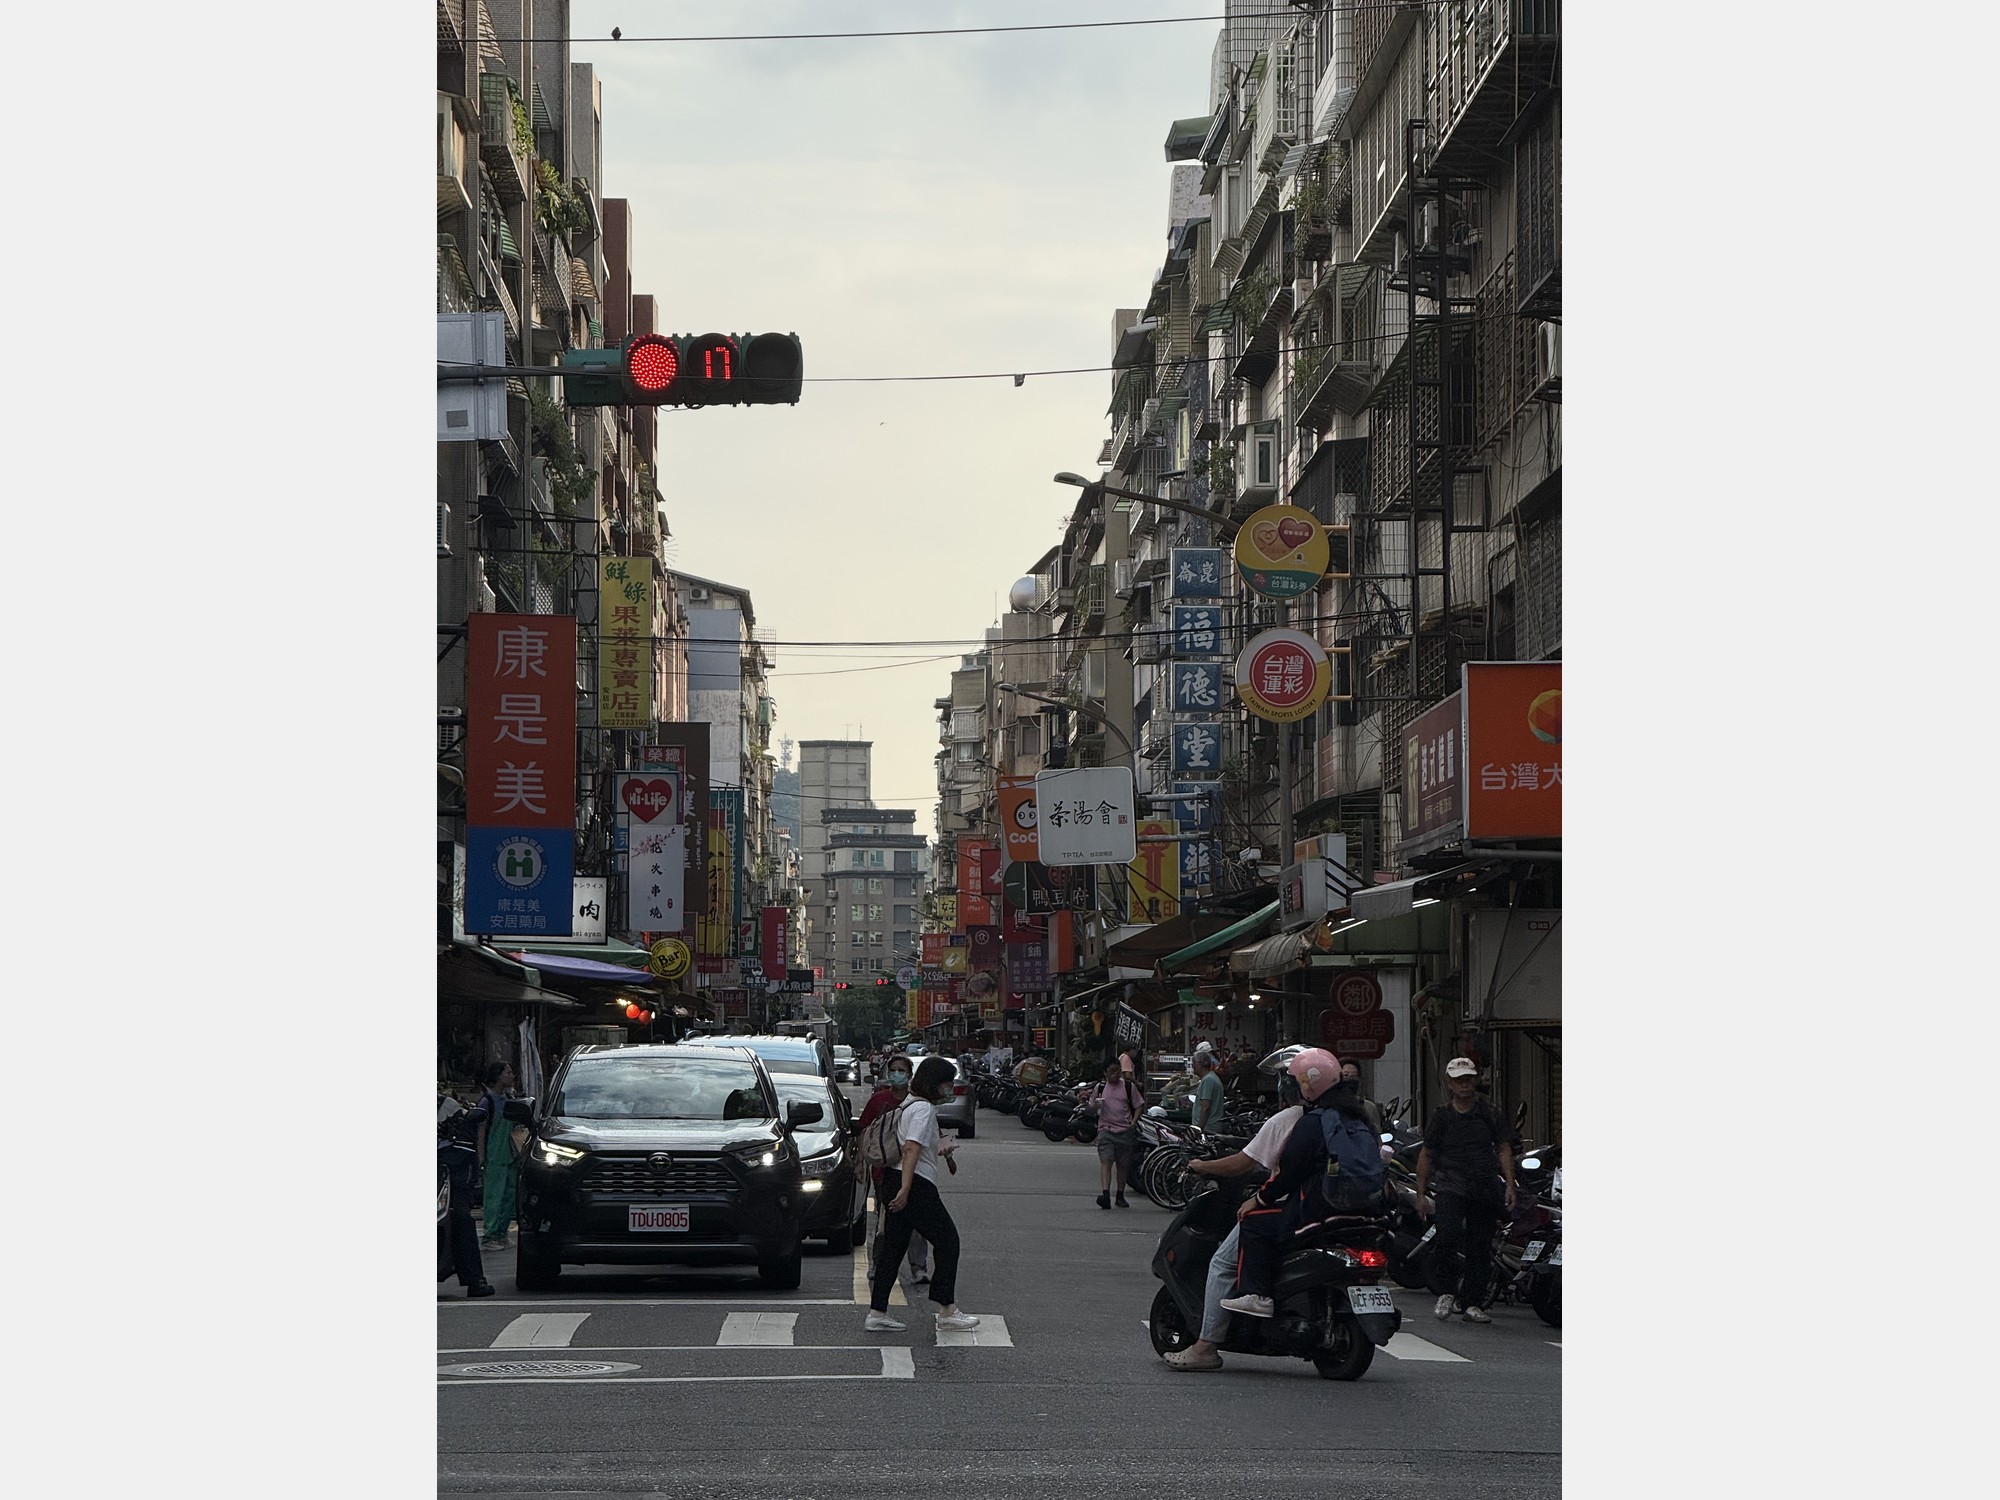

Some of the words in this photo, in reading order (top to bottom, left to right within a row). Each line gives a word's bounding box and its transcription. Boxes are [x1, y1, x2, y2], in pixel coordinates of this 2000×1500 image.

[705, 346, 732, 380] 17
[1264, 655, 1304, 674] 台灣
[1262, 675, 1304, 694] 運彩
[1249, 696, 1270, 716] TAIWAN
[1271, 710, 1294, 718] SPORTS
[1294, 699, 1317, 716] LOTTERY
[493, 625, 549, 815] 康是美
[1481, 762, 1562, 791] 台灣大
[1049, 800, 1118, 828] 茶湯會
[1009, 832, 1038, 843] CoC
[497, 898, 541, 912] 康是美
[579, 900, 601, 921] 肉
[490, 914, 547, 929] 安居藥局
[631, 1212, 689, 1228] TDU-0805
